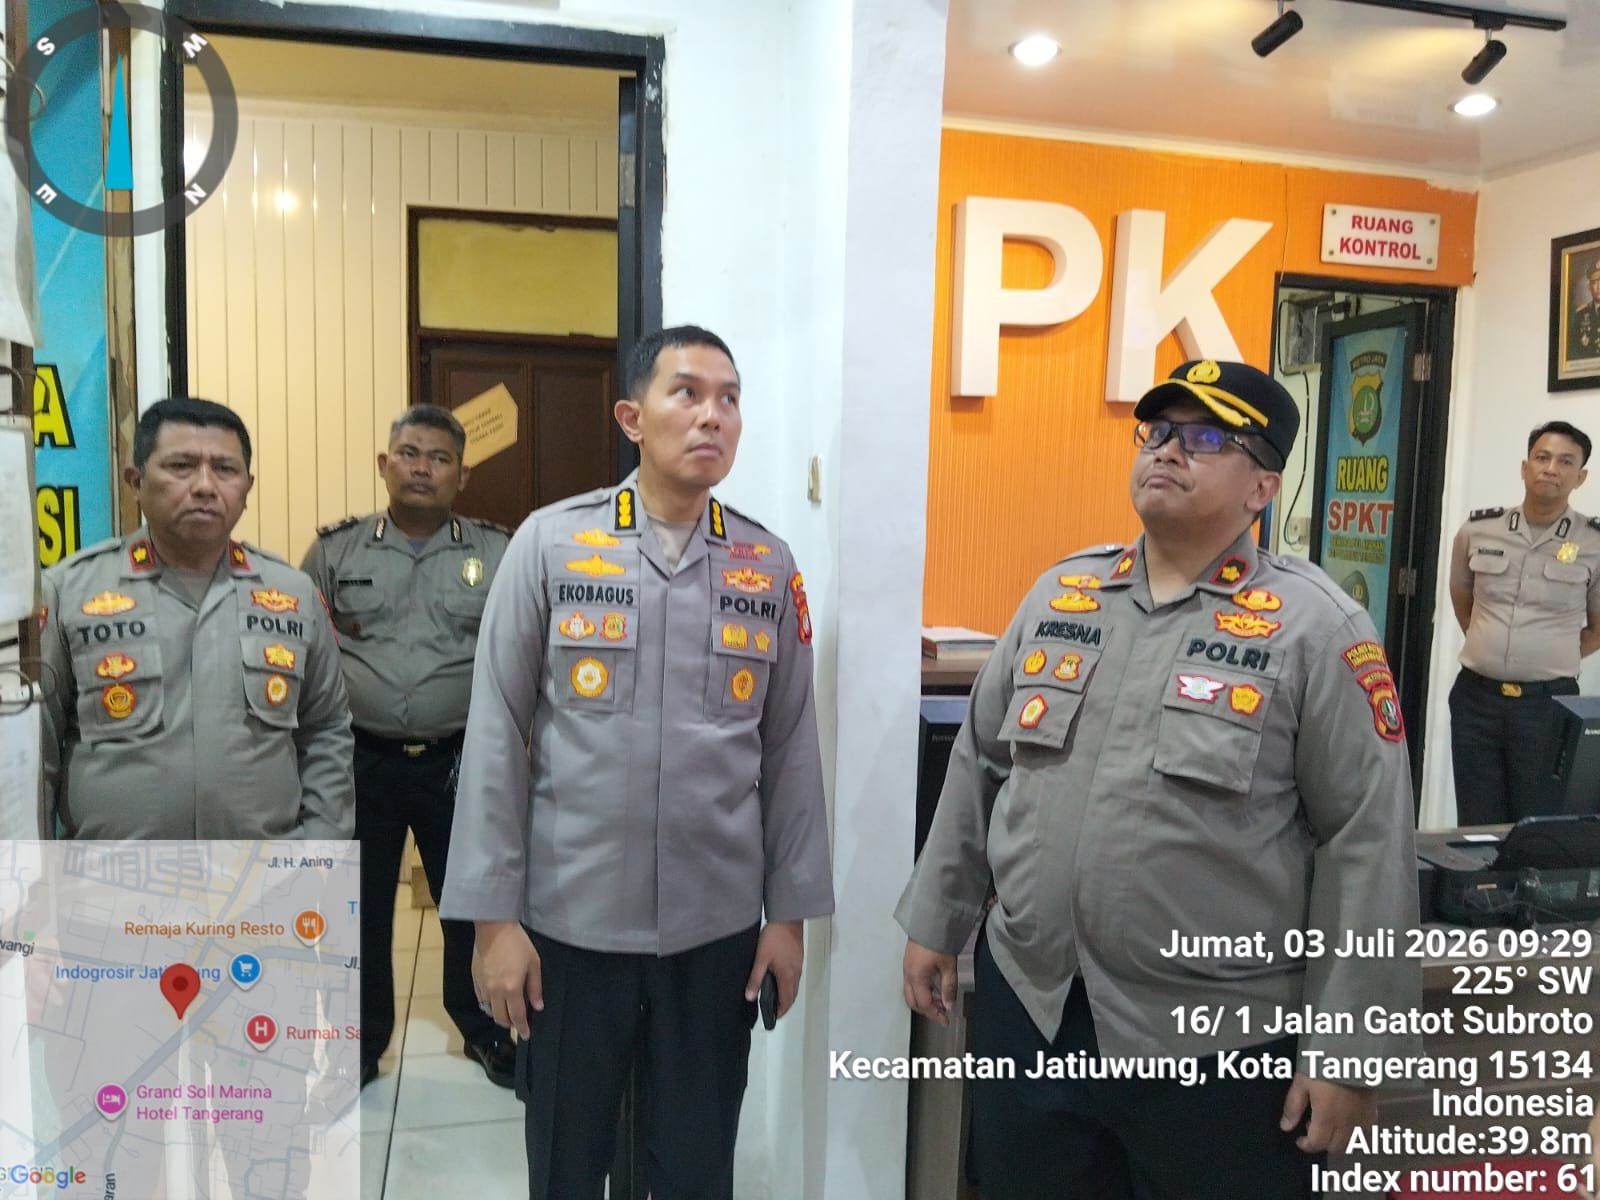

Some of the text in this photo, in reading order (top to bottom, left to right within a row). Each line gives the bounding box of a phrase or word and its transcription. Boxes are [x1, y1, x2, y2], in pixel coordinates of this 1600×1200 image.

[1351, 214, 1414, 234] RUANG
[1339, 236, 1422, 261] KONTROL
[951, 195, 1274, 403] PK
[1336, 455, 1389, 493] RUANG
[1327, 499, 1394, 536] SPKT
[558, 584, 634, 605] EKOBAGUS
[719, 595, 777, 620] POLRI
[77, 619, 146, 645] TOTO
[246, 614, 304, 639] POLRI
[1034, 620, 1101, 646] KRESNA
[1186, 638, 1271, 671] POLRI
